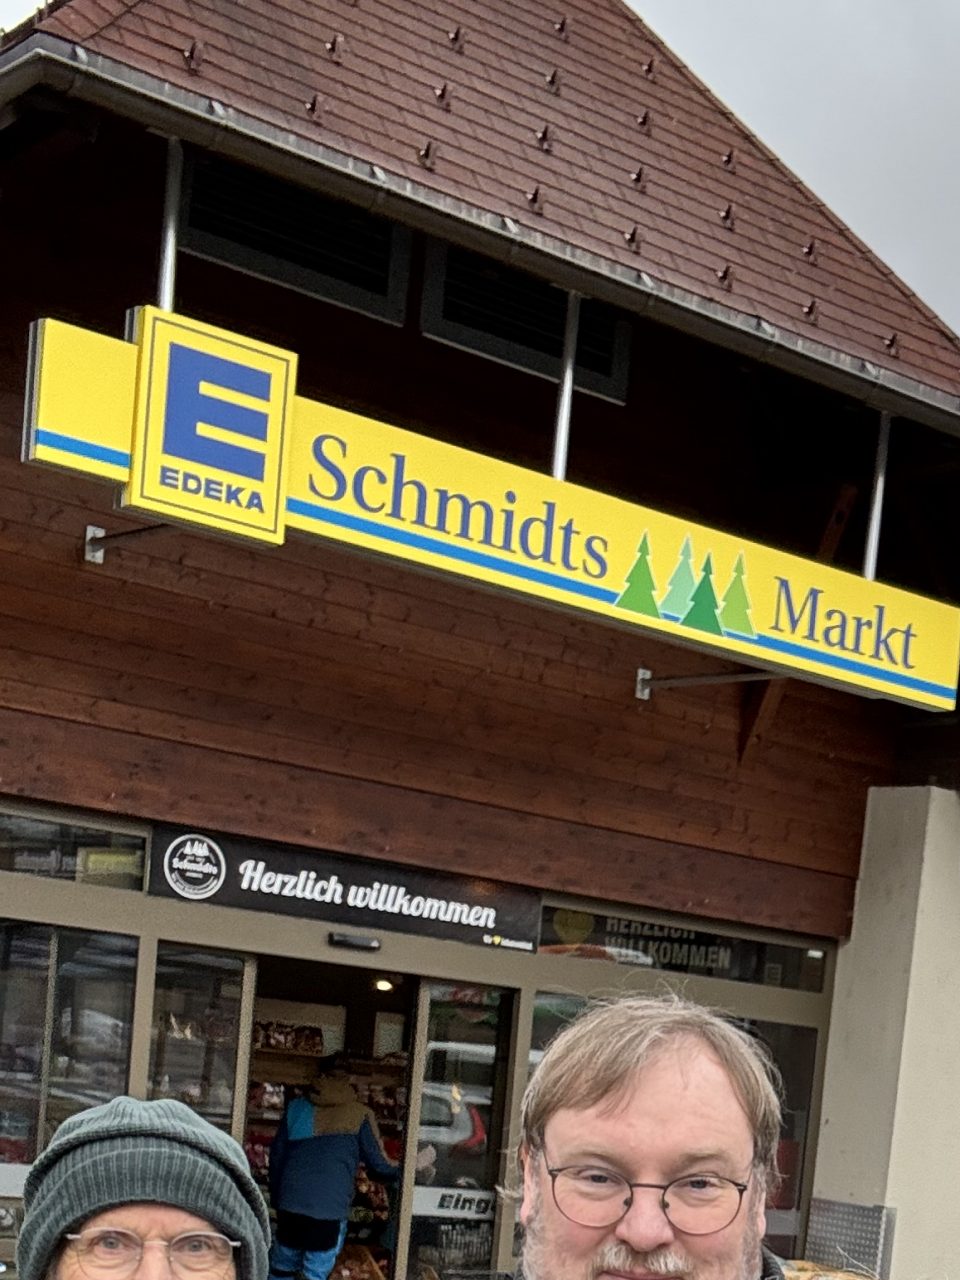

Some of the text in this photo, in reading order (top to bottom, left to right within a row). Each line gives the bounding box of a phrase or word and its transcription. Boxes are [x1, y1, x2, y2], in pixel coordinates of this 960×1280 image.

[160, 465, 265, 514] EDEKA
[308, 433, 917, 670] Schmidts Markt
[239, 859, 342, 904] Herzlich
[346, 882, 496, 928] willkommen
[438, 1192, 496, 1215] Eing
